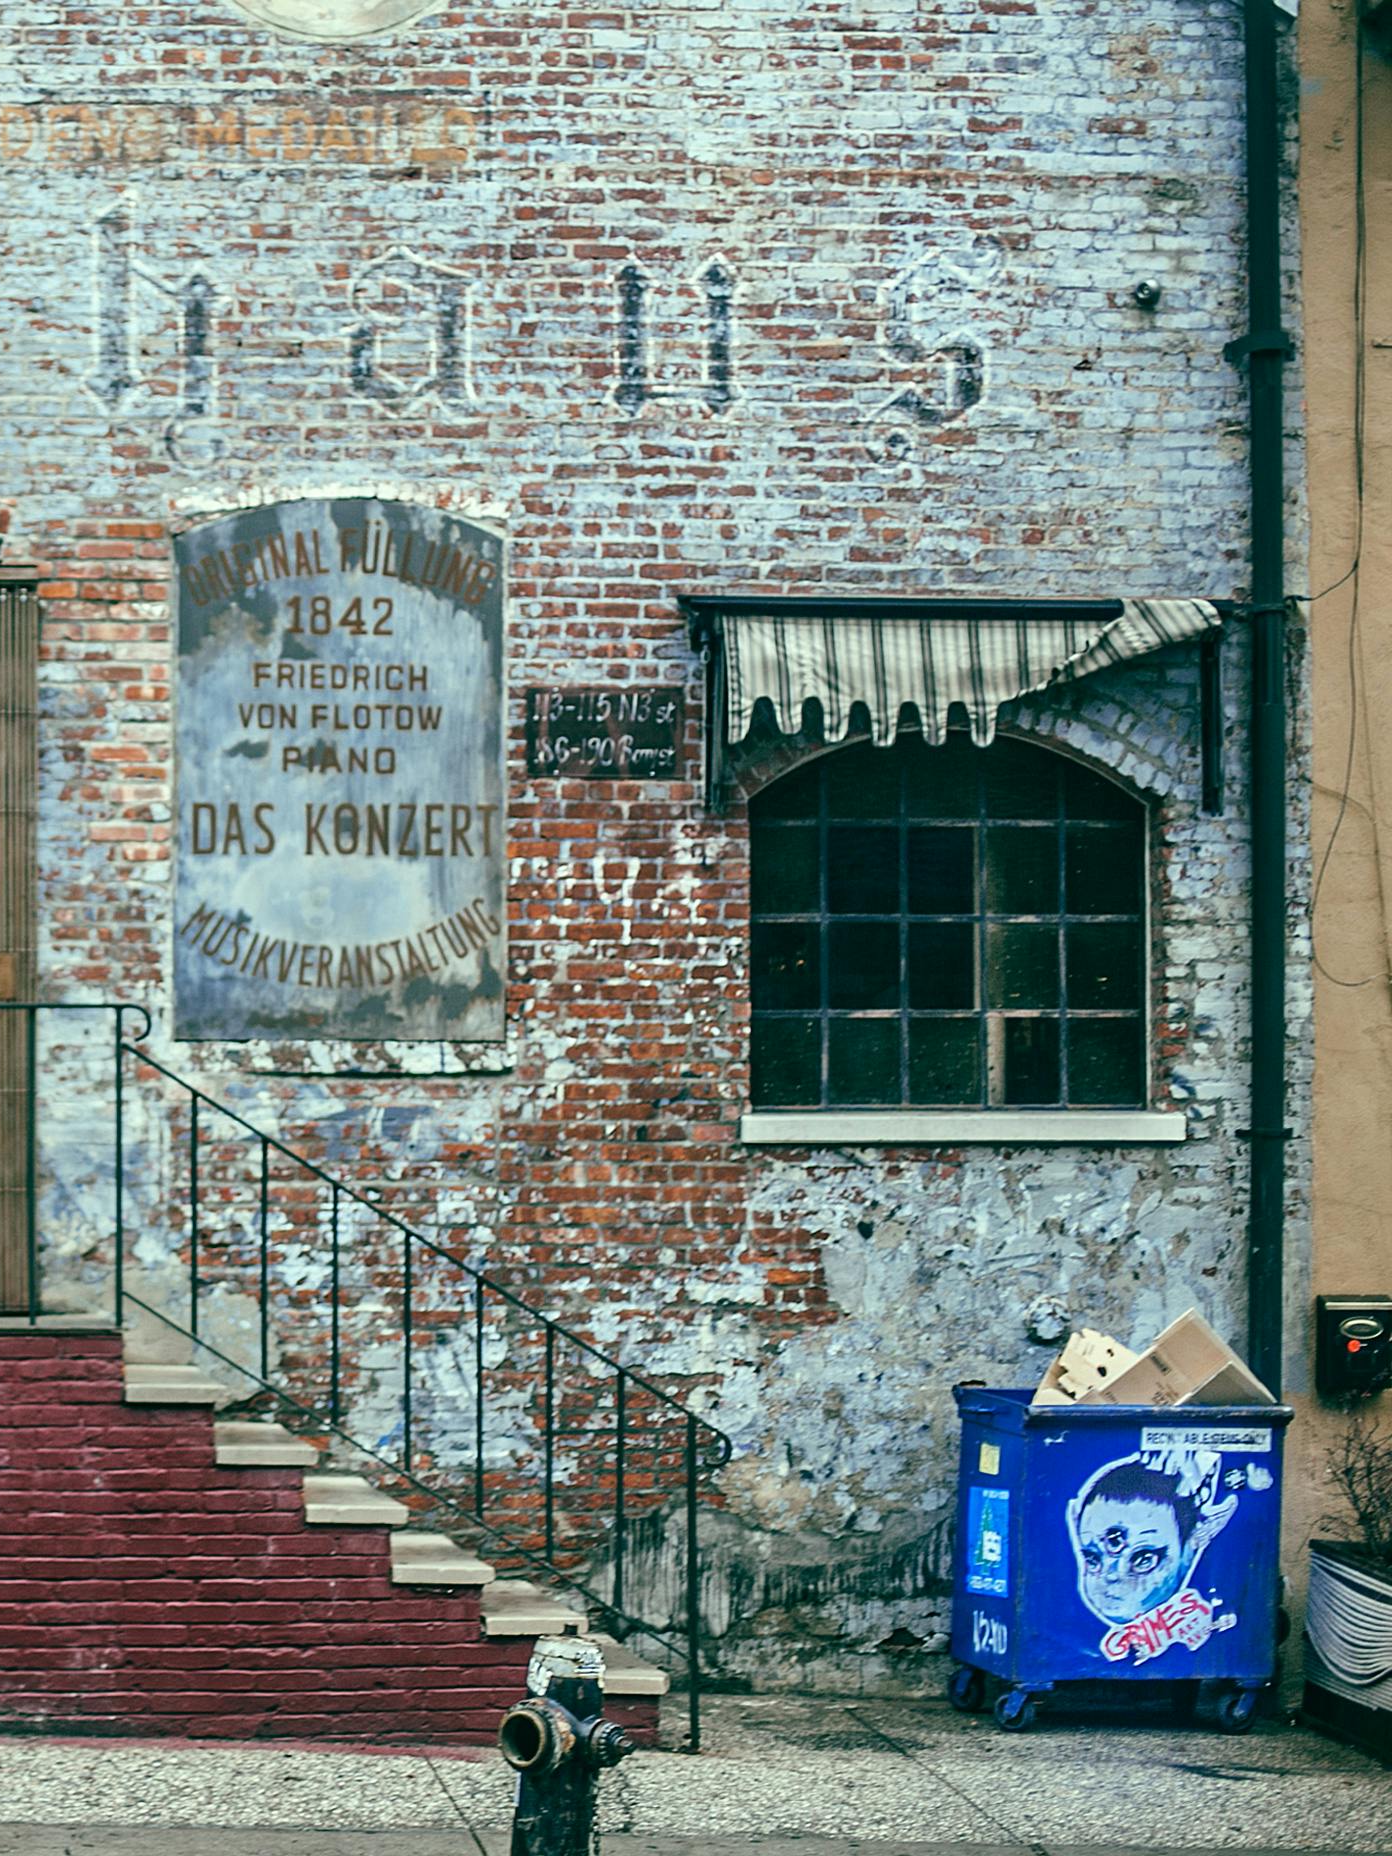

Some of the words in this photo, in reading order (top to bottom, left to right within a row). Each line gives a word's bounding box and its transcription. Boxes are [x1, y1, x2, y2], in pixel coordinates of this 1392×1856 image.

[185, 528, 330, 606] ORIGINAL
[338, 519, 496, 605] FÜLLUNG
[286, 596, 394, 636] 1842
[252, 662, 428, 691] FRIEDRICH
[238, 703, 298, 730] VON
[310, 704, 443, 731] FLOTOW
[281, 746, 397, 774] PIANO
[191, 803, 276, 856] DAS
[304, 803, 500, 858] KONZERT
[180, 897, 502, 989] MUSIKVERANSTALTUNG
